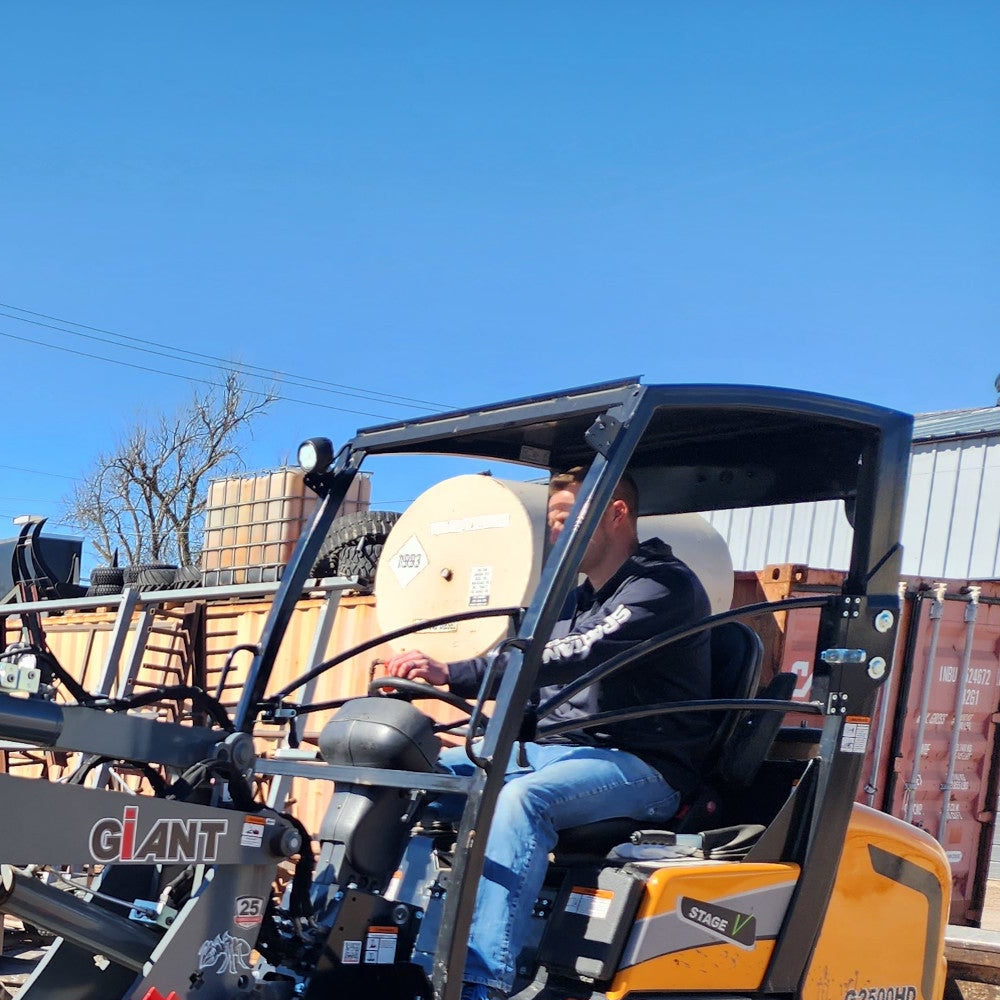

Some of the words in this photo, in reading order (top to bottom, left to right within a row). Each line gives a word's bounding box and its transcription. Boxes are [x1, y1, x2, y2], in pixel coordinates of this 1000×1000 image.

[541, 604, 632, 664] SPARTAN
[239, 899, 259, 916] 25
[688, 906, 729, 932] STAGE
